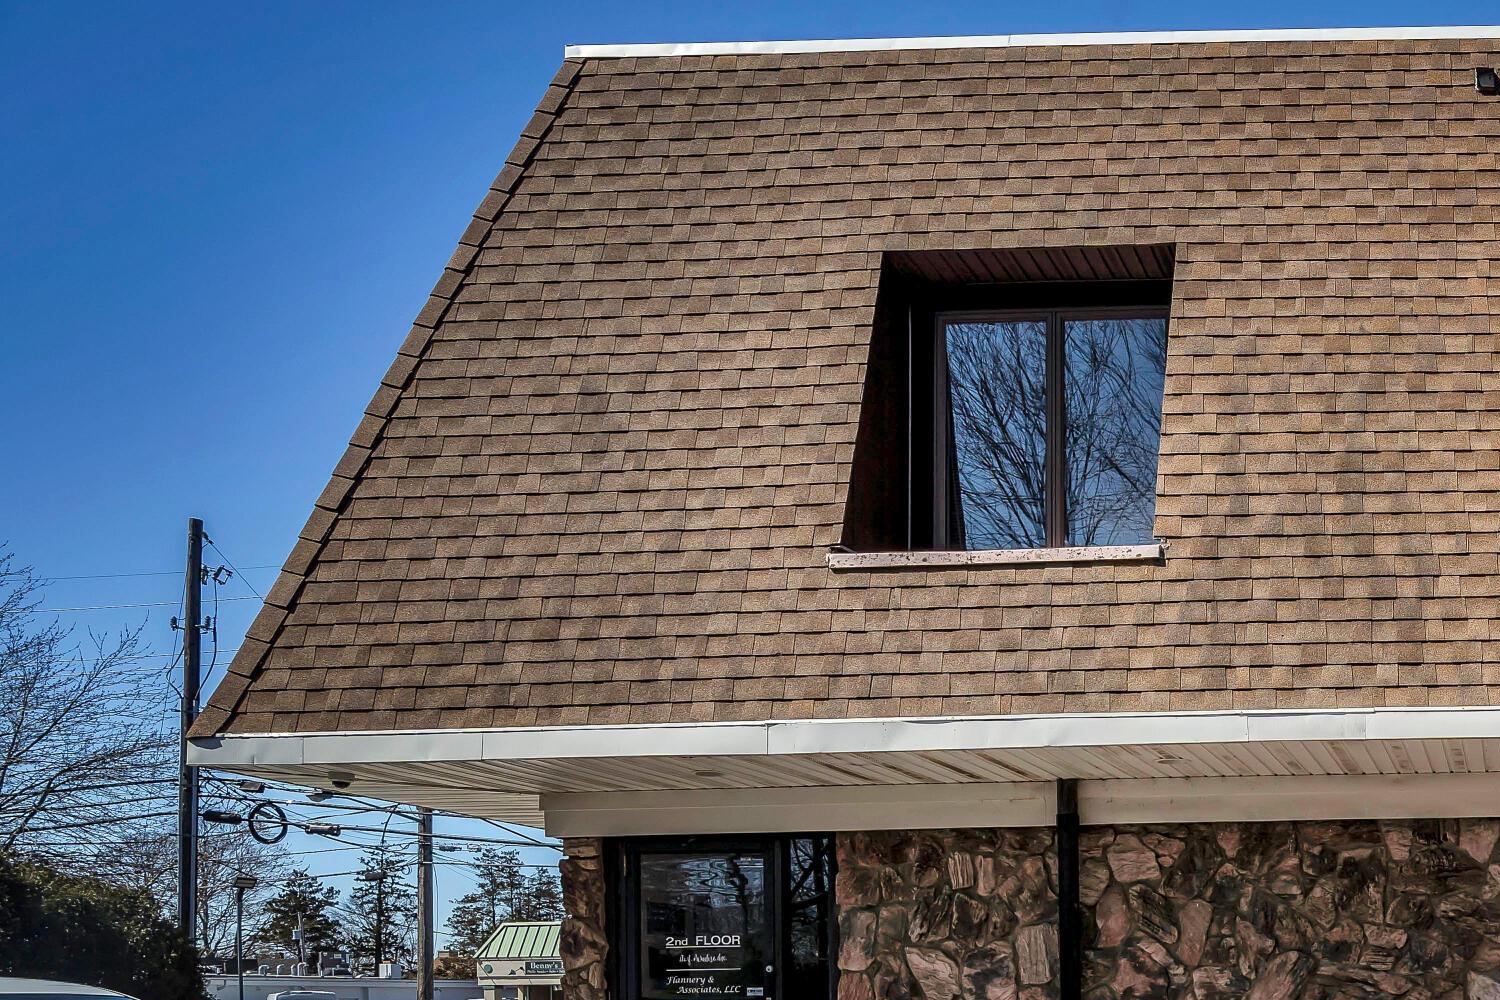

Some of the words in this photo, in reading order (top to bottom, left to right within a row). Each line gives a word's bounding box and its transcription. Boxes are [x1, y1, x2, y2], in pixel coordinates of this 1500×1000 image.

[665, 936, 688, 946] 2nd
[695, 935, 741, 946] FLOOR
[530, 961, 559, 969] Benny's
[666, 975, 706, 986] Flannery
[707, 975, 715, 984] &
[677, 986, 722, 994] Associates,
[724, 985, 742, 993] LLC
